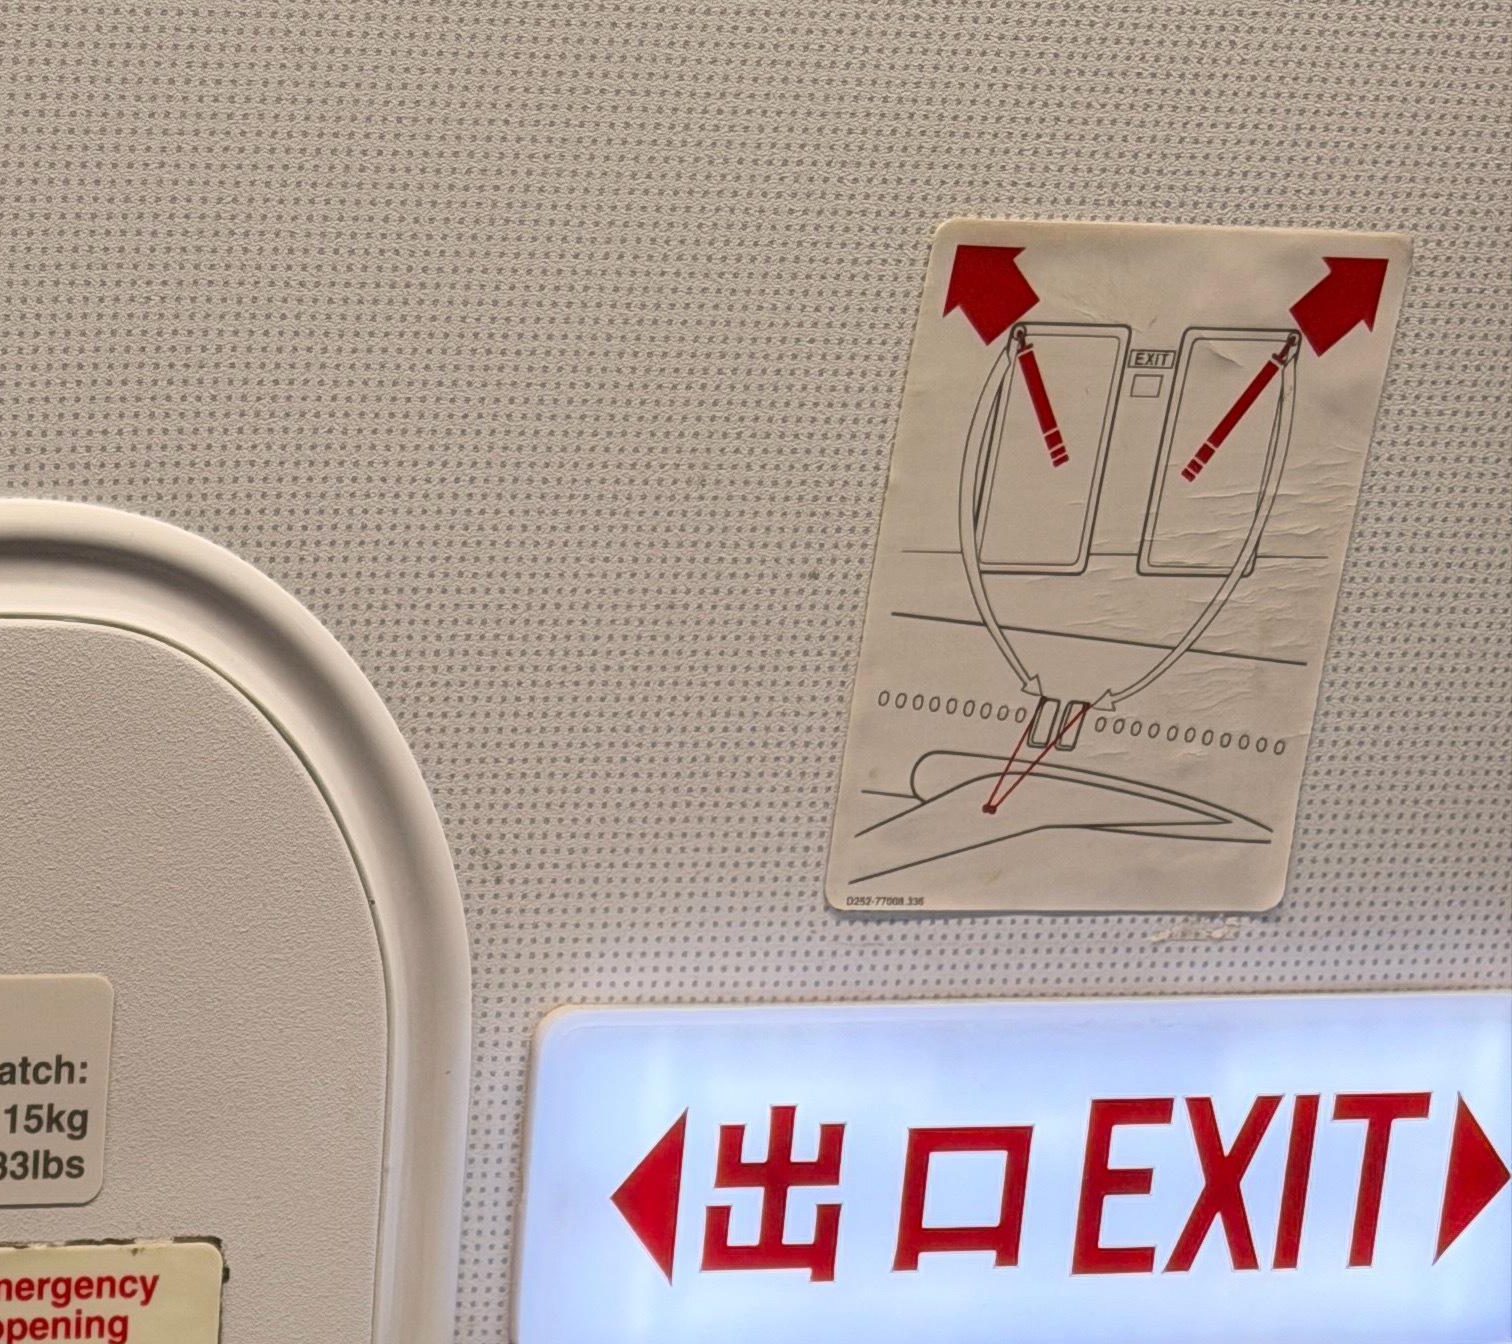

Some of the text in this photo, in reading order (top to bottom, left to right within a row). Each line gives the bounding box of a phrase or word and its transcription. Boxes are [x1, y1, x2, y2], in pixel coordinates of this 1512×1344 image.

[1134, 352, 1172, 367] EXIT
[3, 1102, 89, 1141] 15kg
[699, 1091, 1433, 1283] 出口 EXIT
